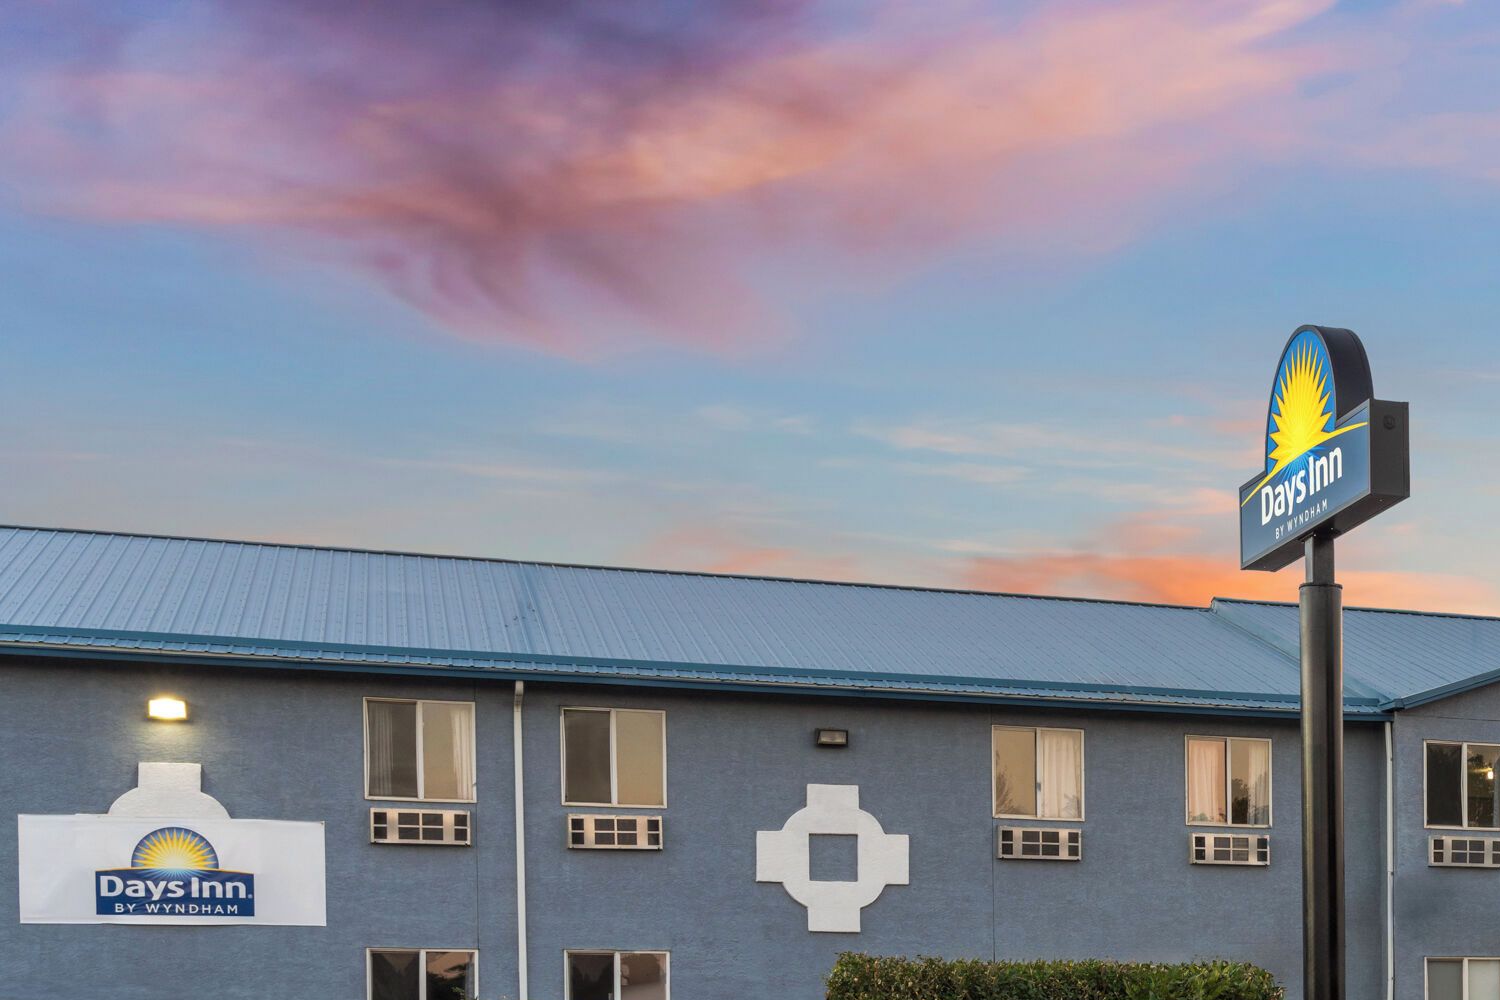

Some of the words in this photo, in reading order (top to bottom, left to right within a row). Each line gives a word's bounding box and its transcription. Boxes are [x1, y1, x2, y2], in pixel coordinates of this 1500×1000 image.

[1261, 469, 1307, 526] Days
[1308, 447, 1342, 496] Inn
[1275, 525, 1284, 540] BY
[1286, 498, 1328, 532] WYNDHAM
[99, 875, 185, 901] Days
[191, 877, 247, 899] Inn
[114, 903, 135, 913] BY
[145, 903, 238, 914] WYNDHAM
